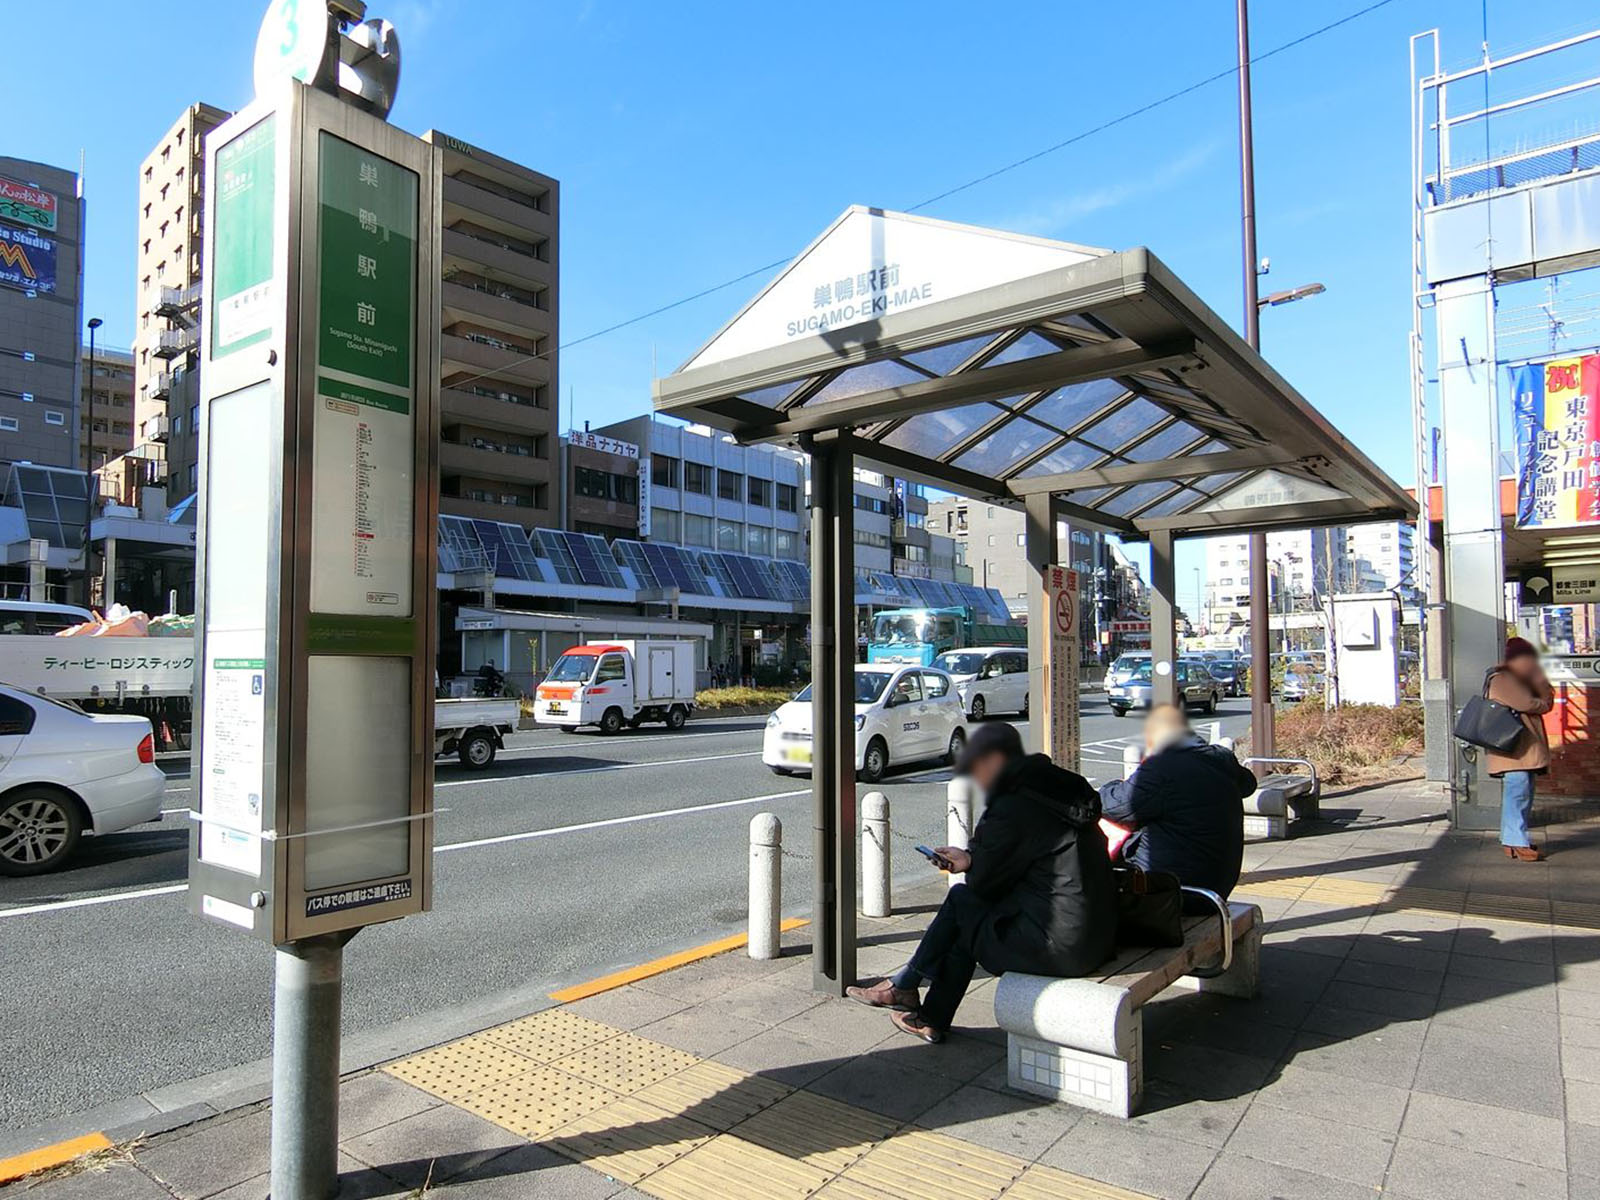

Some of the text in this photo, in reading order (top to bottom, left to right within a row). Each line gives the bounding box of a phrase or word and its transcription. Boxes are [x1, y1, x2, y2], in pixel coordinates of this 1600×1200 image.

[12, 230, 51, 251] Studio
[357, 162, 379, 326] 巣鴨駅前
[330, 327, 352, 339] Sugamo
[1546, 364, 1580, 393] 祝
[571, 431, 637, 457] 洋品ナカヤ
[1563, 397, 1587, 491] 東京戸田
[1536, 430, 1559, 521] 記念講堂
[1052, 568, 1076, 591] 禁煙
